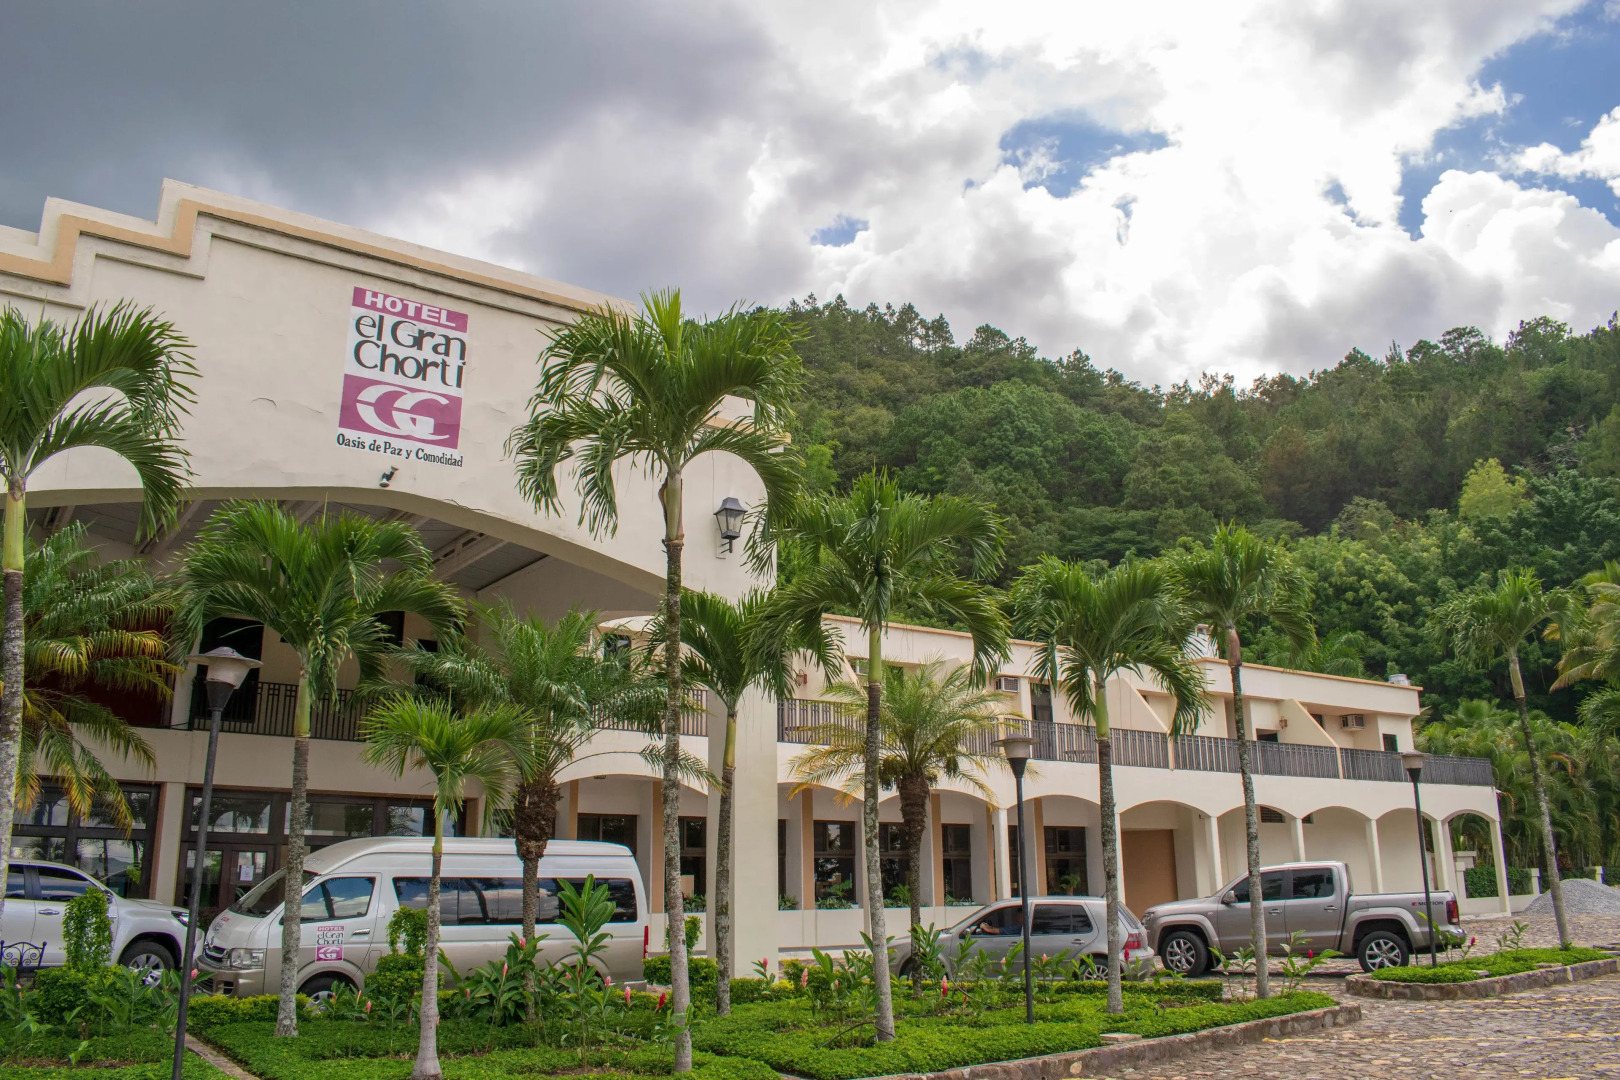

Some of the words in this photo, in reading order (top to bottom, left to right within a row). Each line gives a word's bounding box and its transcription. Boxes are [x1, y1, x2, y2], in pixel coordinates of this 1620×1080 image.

[364, 290, 456, 327] HOTEL
[355, 314, 385, 341] el
[390, 319, 467, 360] Gran
[336, 433, 366, 450] Oasis
[368, 439, 382, 452] de
[383, 441, 403, 456] Paz
[405, 449, 413, 460] y
[415, 447, 464, 468] Comodidad
